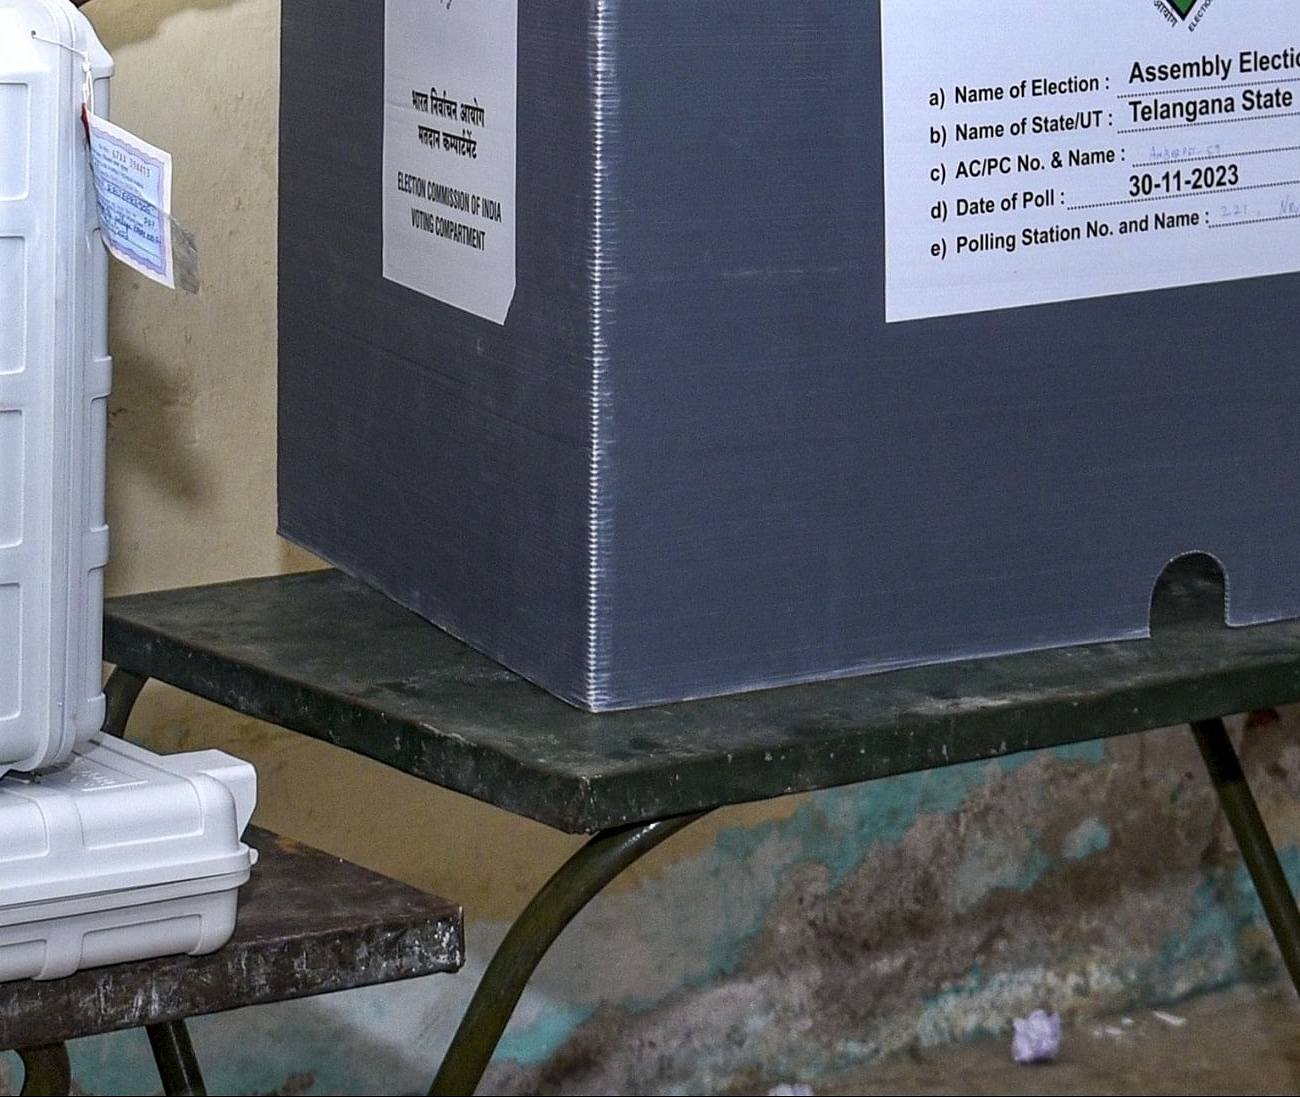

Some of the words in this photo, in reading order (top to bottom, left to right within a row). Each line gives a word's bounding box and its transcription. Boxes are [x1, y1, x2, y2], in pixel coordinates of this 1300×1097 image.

[929, 88, 945, 109] a)
[955, 85, 1003, 104] Name
[1009, 81, 1026, 98] of
[1032, 75, 1099, 96] Election
[1128, 54, 1232, 84] Assembly
[412, 90, 428, 113] भारत
[430, 87, 458, 120] निर्वाचन
[460, 97, 485, 128] आयोग
[930, 126, 947, 147] b)
[955, 123, 1004, 141] Name
[1010, 117, 1027, 136] of
[1032, 110, 1103, 133] State/UT
[1128, 93, 1235, 123] Telangana
[1241, 87, 1294, 112] State
[930, 163, 946, 185] c)
[955, 156, 1011, 179] AC/PC
[1017, 153, 1045, 171] No.
[1051, 151, 1063, 169] &
[1068, 148, 1115, 167] Name
[398, 171, 427, 197] ELECTION
[427, 182, 470, 213] COMMISSION
[471, 195, 481, 215] OF
[482, 198, 502, 222] INDIA
[930, 201, 948, 222] d)
[956, 197, 995, 216] Date
[1001, 193, 1017, 211] of
[1022, 188, 1054, 208] Poll
[1128, 163, 1240, 197] 30-11-2023
[411, 207, 434, 234] VOTING
[435, 216, 486, 251] COMPARTMENT
[930, 238, 946, 260] e)
[956, 231, 1016, 254] Polling
[1021, 224, 1081, 246] Station
[1086, 220, 1114, 238] No.
[1118, 215, 1149, 234] and
[1154, 212, 1200, 230] Name
